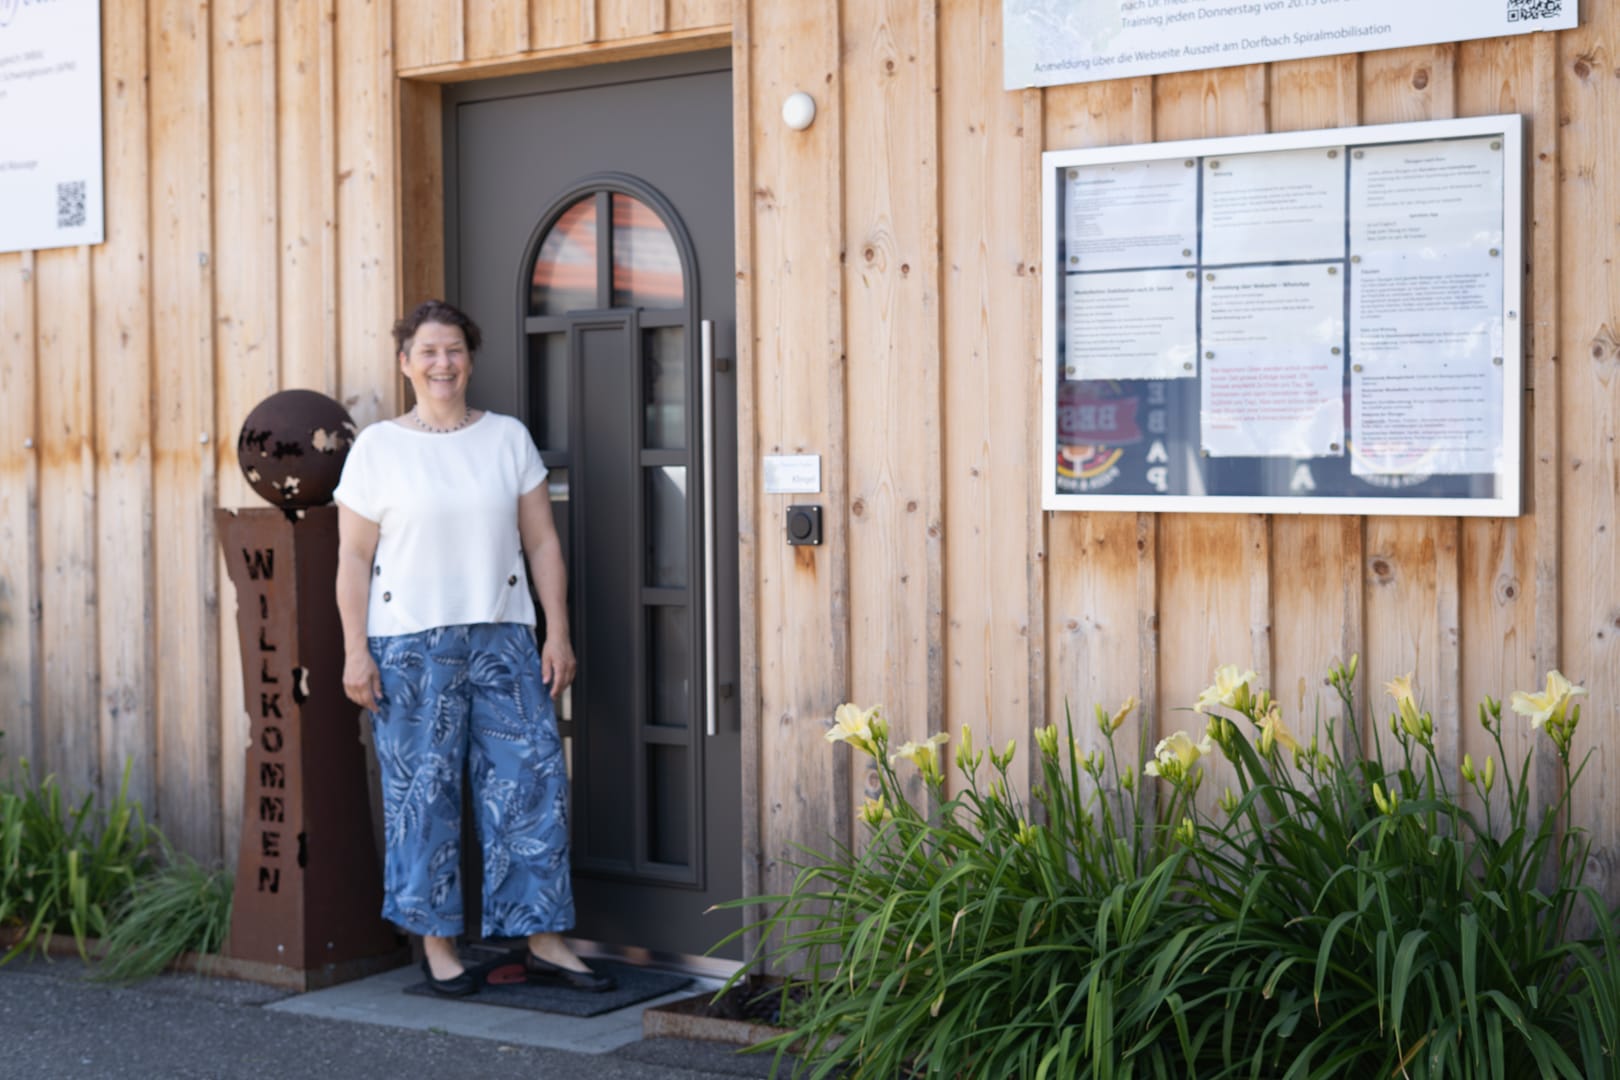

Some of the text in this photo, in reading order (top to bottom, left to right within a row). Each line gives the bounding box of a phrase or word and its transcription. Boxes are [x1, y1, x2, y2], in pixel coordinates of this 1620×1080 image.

[1121, 15, 1163, 28] Training
[1165, 10, 1195, 25] jeden
[1198, 4, 1261, 19] Donnerstag
[1264, 2, 1285, 11] von
[1033, 23, 1391, 73] Anmeldung über die Webseite Auszeit am Dorfbach Spiralmobilisation
[242, 548, 285, 894] WILLKOMMEN
